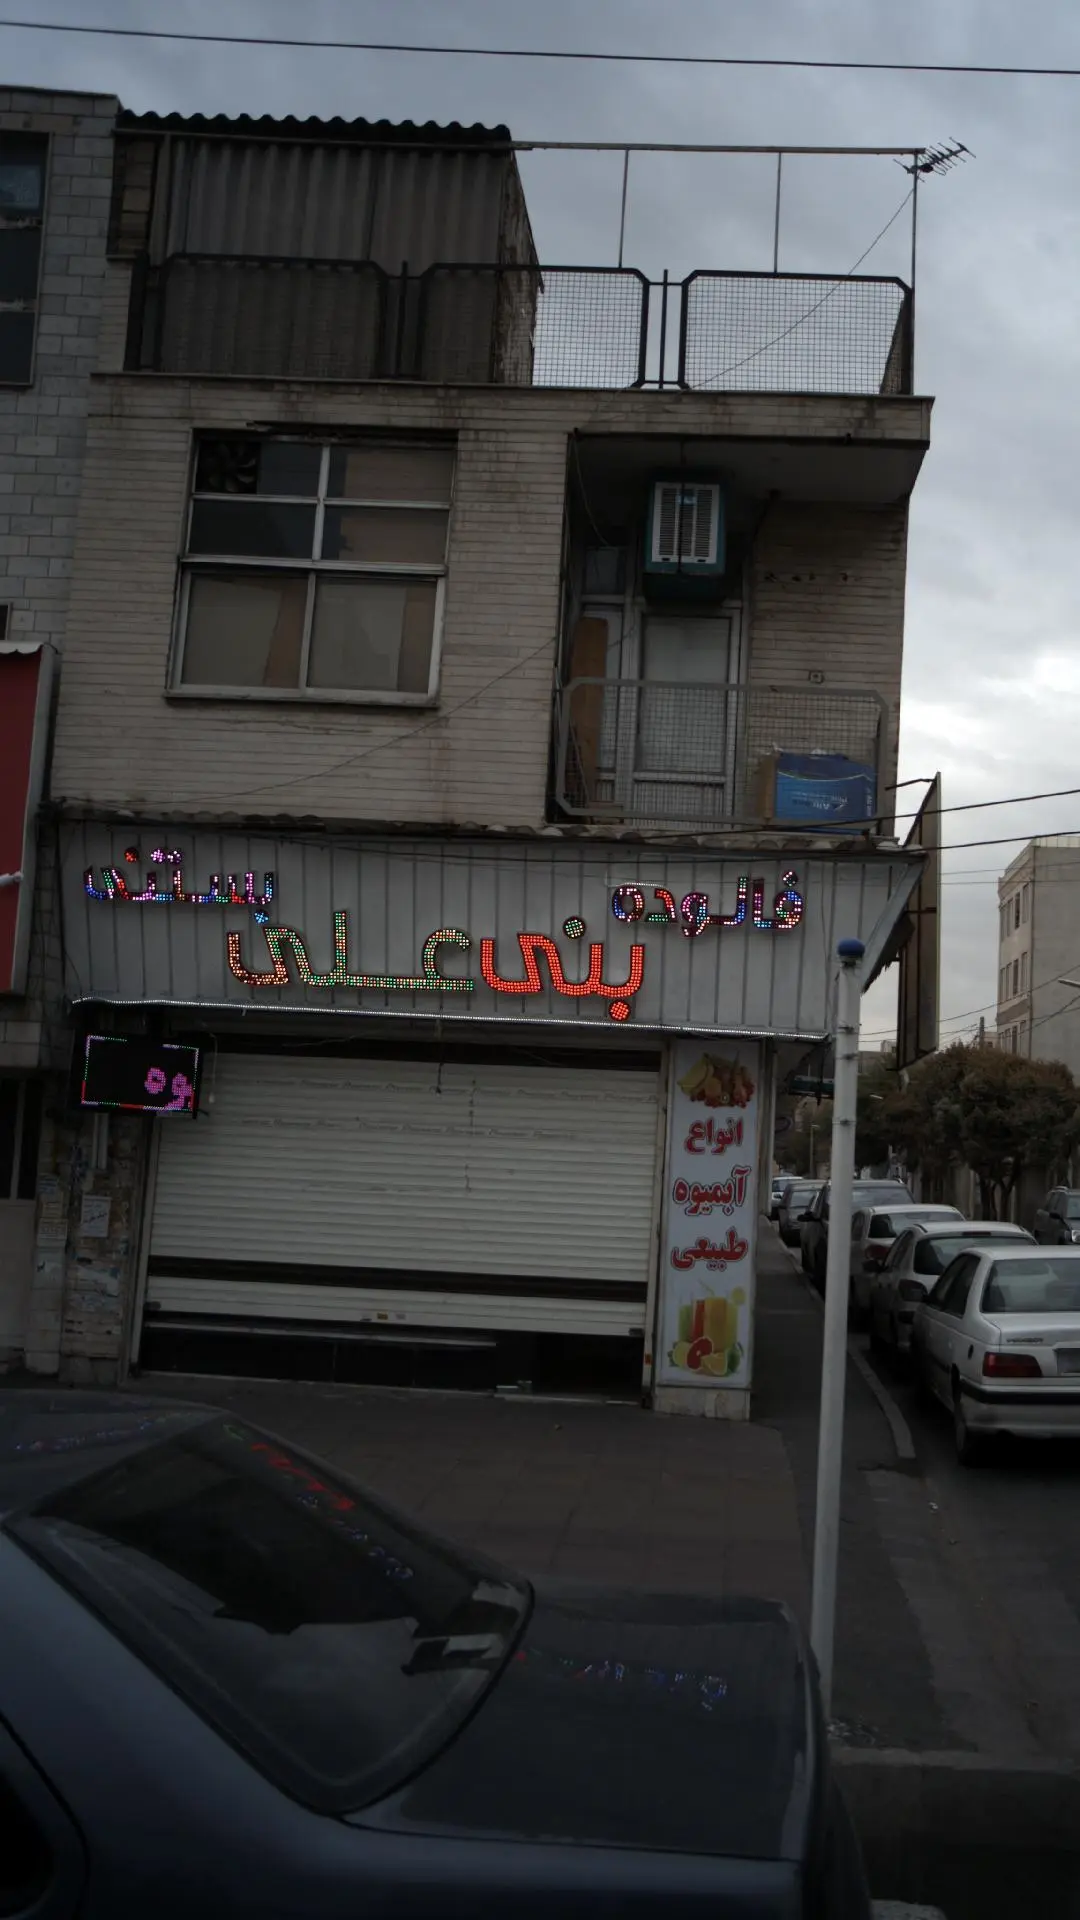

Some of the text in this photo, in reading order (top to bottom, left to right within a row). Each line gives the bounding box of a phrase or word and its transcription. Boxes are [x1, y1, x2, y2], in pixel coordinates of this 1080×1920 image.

[83, 846, 804, 938] فالوده بستنی
[226, 911, 646, 1022] بنی علی
[684, 1116, 744, 1155] انواع
[673, 1165, 752, 1216] آبمیوه
[671, 1226, 749, 1271] طبیعی
